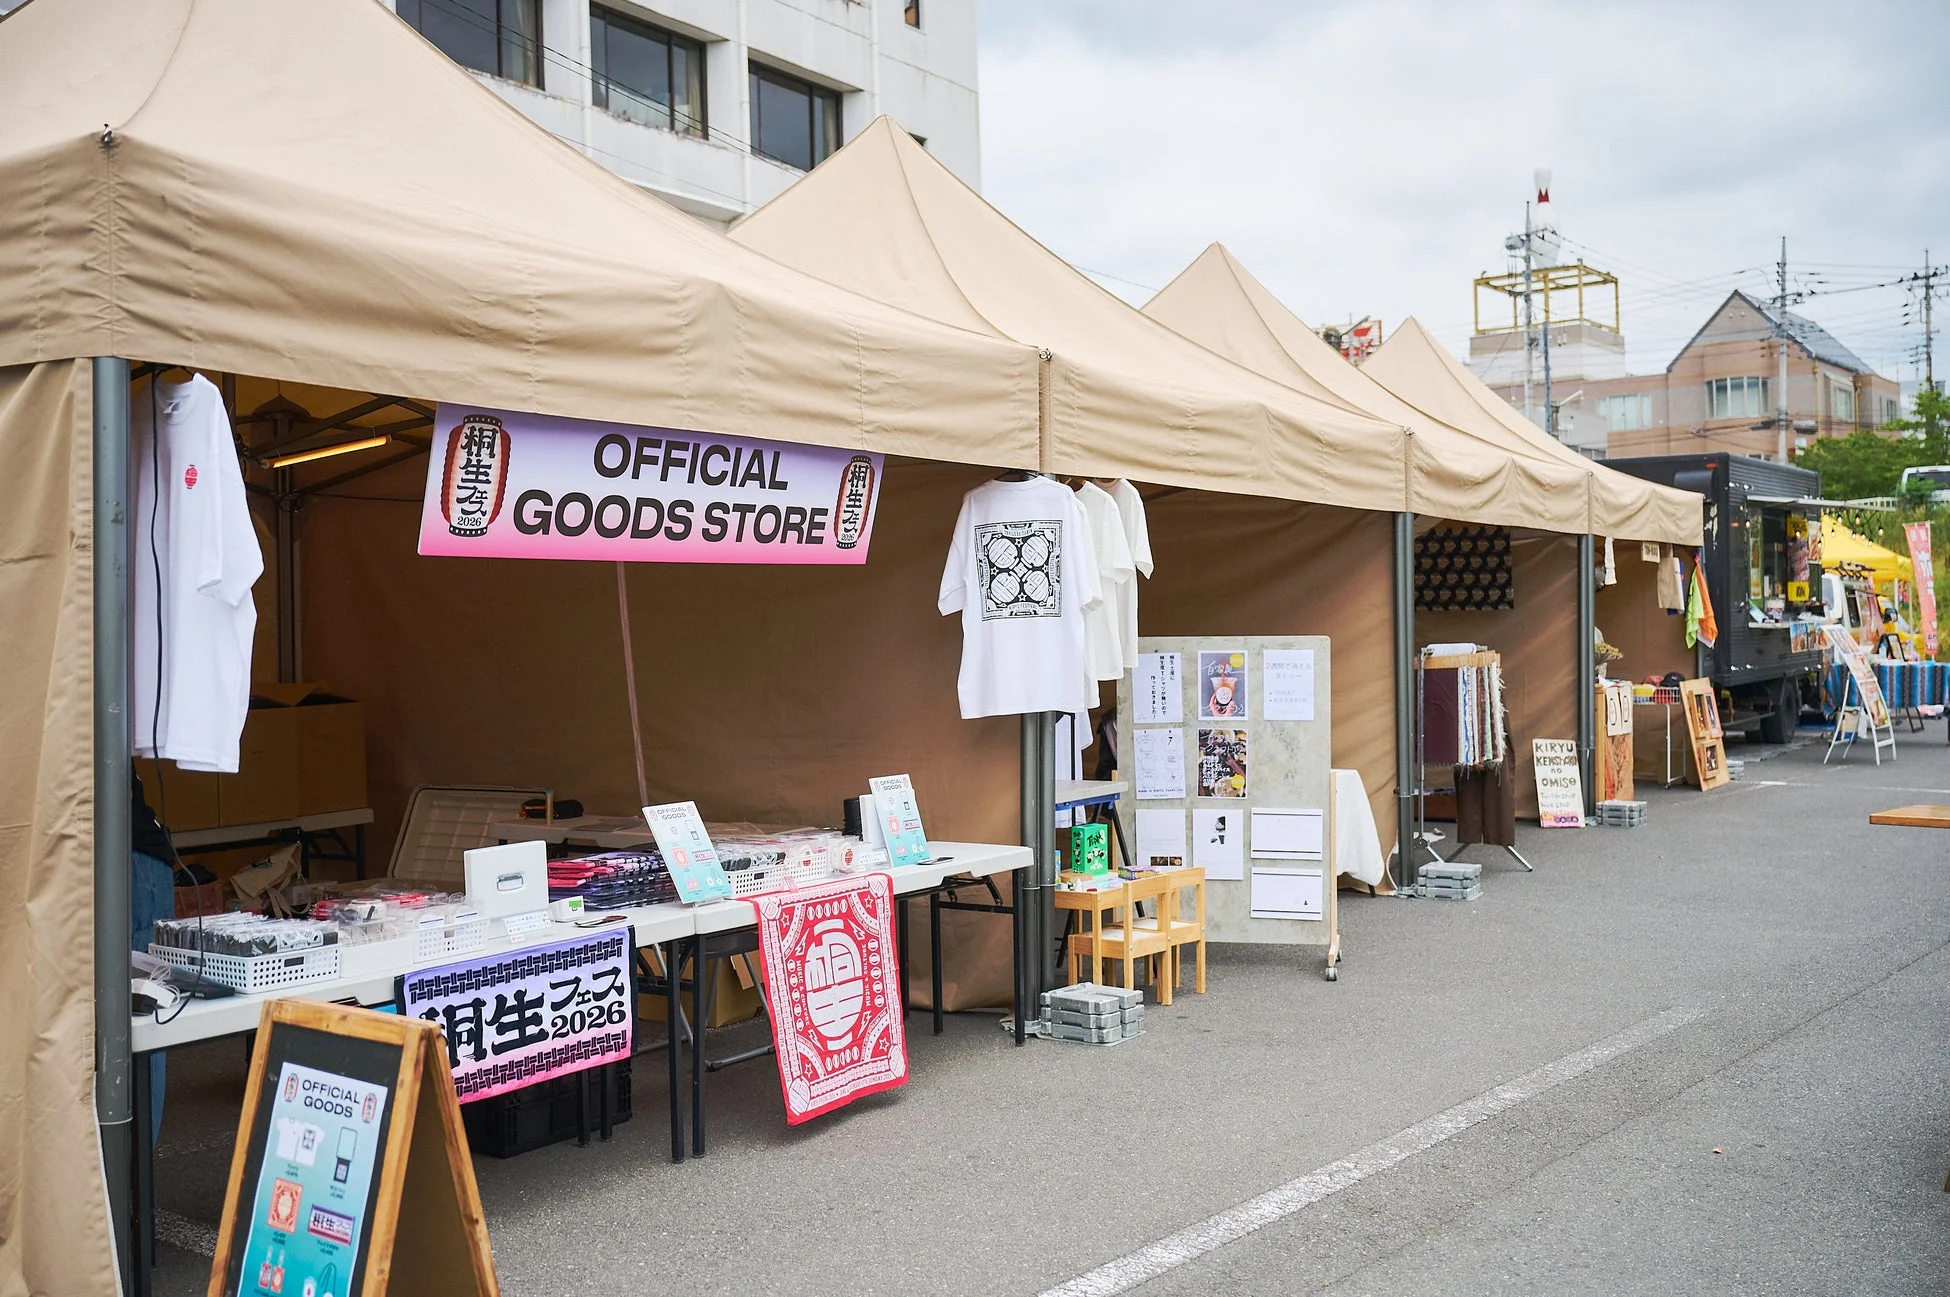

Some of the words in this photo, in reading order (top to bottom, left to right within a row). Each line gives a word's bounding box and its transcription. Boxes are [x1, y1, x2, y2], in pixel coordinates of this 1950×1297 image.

[456, 425, 498, 517] 桐生フェス
[593, 432, 790, 491] OFFICIAL
[457, 516, 482, 527] 2026
[512, 488, 695, 541] GOODS
[701, 501, 829, 544] STORE
[1535, 742, 1574, 753] KIRYU
[880, 778, 903, 786] OFFICIAL
[656, 806, 687, 815] OFFICIAL
[661, 812, 687, 820] GOODS
[551, 1001, 627, 1040] 2026
[302, 1079, 361, 1105] OFFICIAL
[303, 1095, 354, 1119] GOODS
